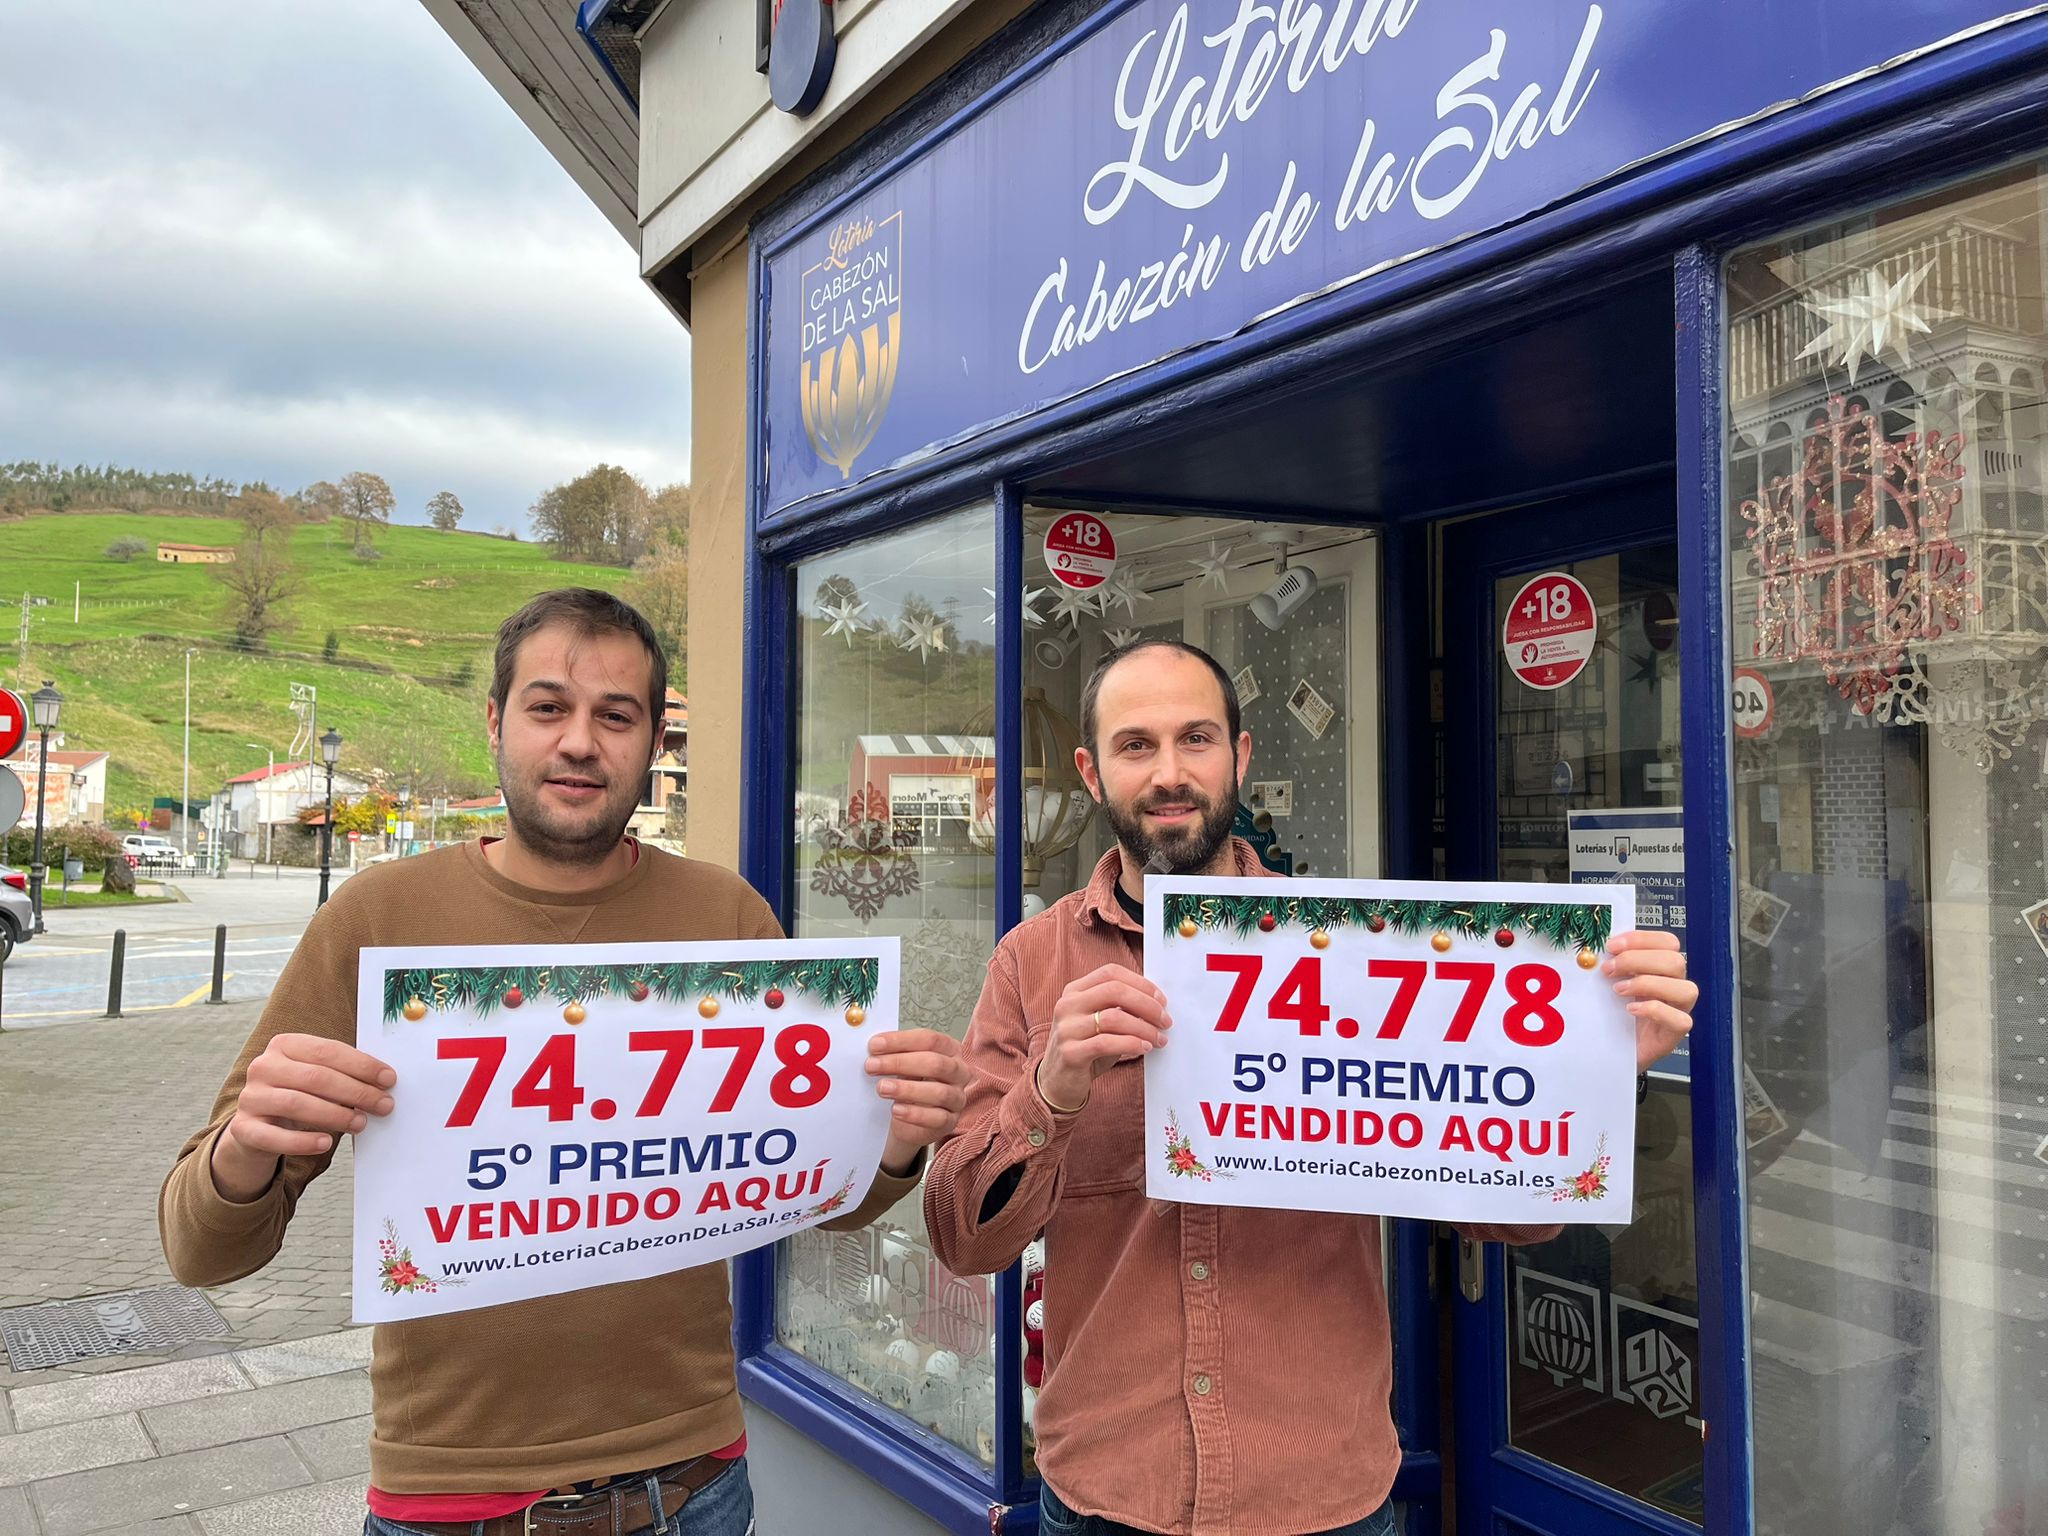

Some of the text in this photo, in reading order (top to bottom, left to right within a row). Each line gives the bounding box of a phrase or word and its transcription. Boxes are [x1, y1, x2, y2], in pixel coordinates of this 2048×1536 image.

[1018, 4, 1602, 373] Cabezón de la Sal
[811, 246, 888, 311] CABEZÓN
[803, 274, 899, 352] DE LA SAL
[1062, 520, 1101, 547] +18
[1522, 584, 1572, 623] +18
[1608, 846, 1614, 856] y
[1632, 842, 1670, 856] Apuestas
[1662, 878, 1675, 887] AL
[1206, 953, 1565, 1047] 74.778
[436, 1024, 831, 1128] 74.778
[1233, 1053, 1535, 1107] 5º PREMIO
[467, 1128, 797, 1191] 5º PREMIO
[1199, 1101, 1576, 1163] VENDIDO AQUÍ
[425, 1158, 832, 1244] VENDIDO AQUÍ
[1214, 1153, 1555, 1189] www.LoteriaCabezonDeLaSal.es
[442, 1207, 802, 1278] www.LoteriaCabezonDeLaSal.es
